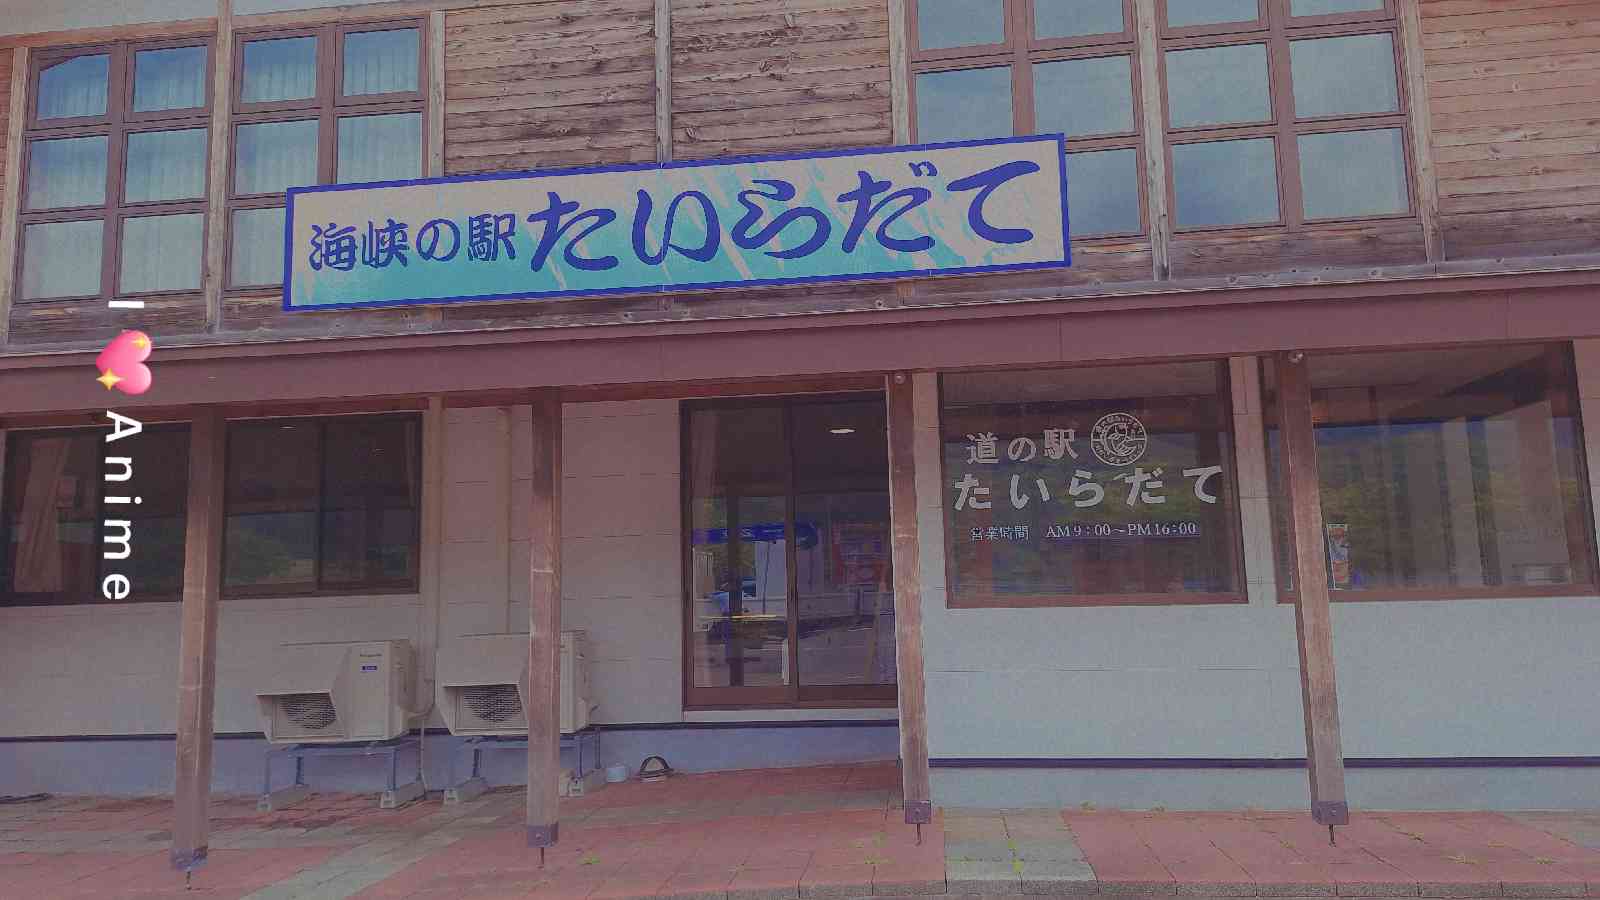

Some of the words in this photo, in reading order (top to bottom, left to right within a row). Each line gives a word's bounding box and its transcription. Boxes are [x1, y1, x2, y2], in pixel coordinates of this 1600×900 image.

[309, 213, 517, 271] 海峡の駅
[526, 160, 1041, 272] たいらだて
[965, 428, 1079, 465] 道の駅
[953, 465, 1223, 511] たいらだて
